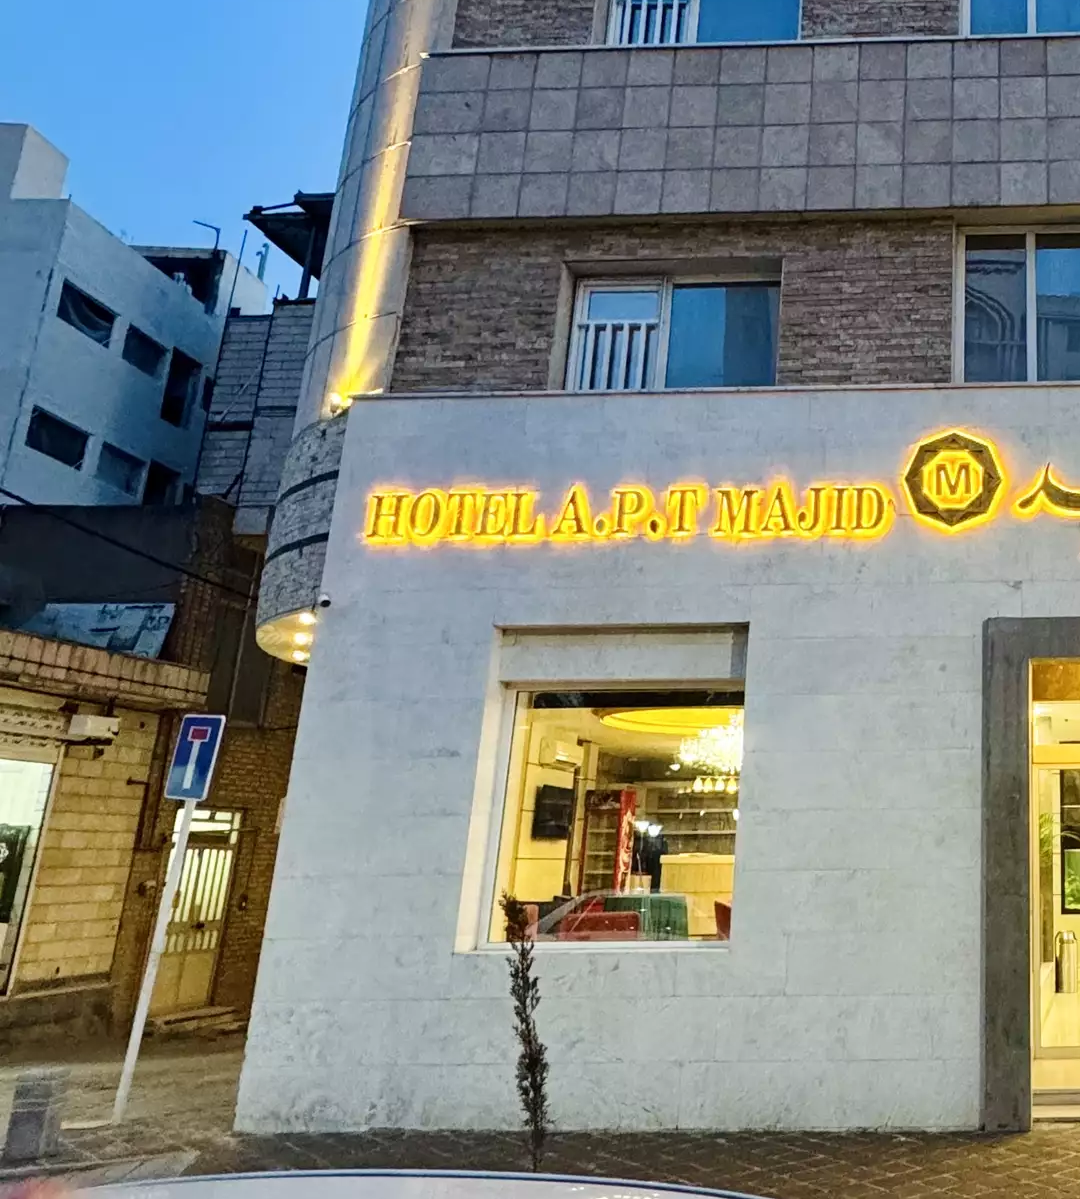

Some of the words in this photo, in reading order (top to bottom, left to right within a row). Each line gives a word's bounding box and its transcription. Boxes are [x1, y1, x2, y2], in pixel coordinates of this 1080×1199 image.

[935, 462, 973, 497] M
[366, 491, 537, 539] HOTEL
[551, 485, 700, 538] A.P.T
[712, 485, 888, 535] MAJID
